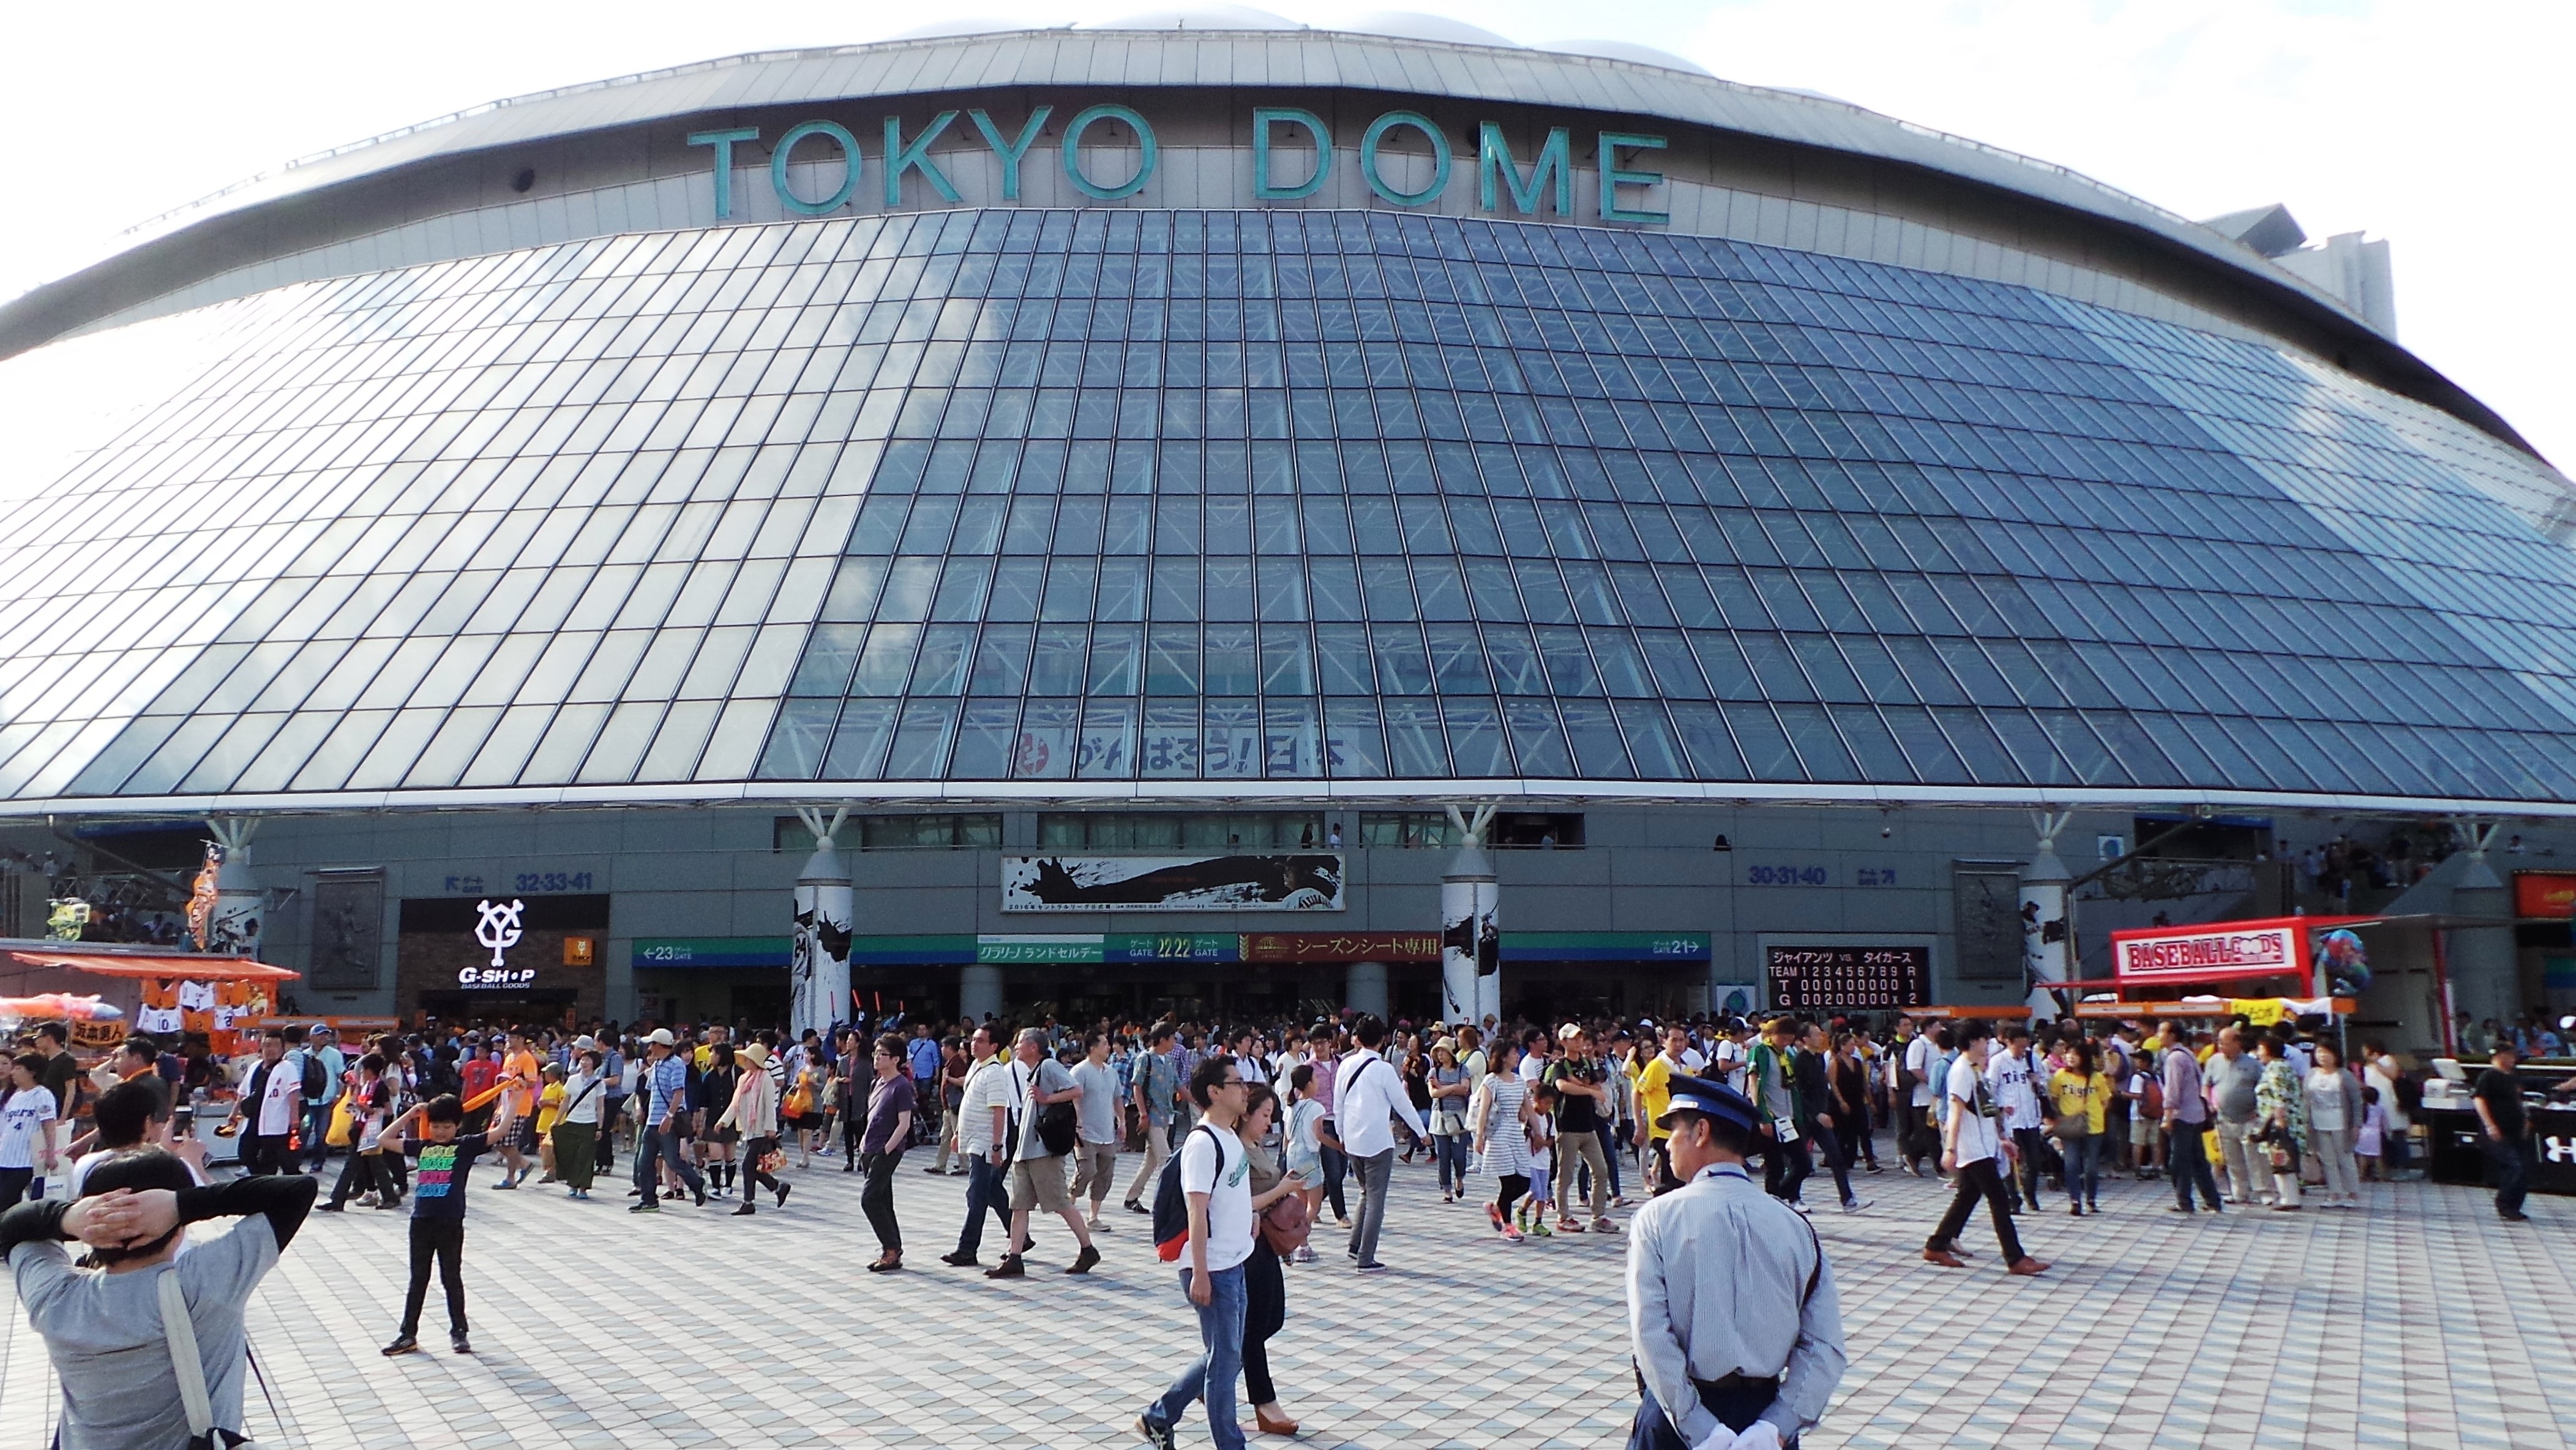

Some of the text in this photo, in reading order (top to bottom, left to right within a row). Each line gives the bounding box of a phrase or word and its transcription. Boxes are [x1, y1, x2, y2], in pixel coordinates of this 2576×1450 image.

[686, 103, 1669, 224] TOKYO DOME
[1130, 939, 1153, 948] ゲート
[1195, 939, 1218, 948] ゲート
[1296, 937, 1443, 955] シーズンシート専用
[1672, 939, 1688, 953] 21
[655, 946, 673, 961] 23
[1024, 945, 1103, 960] ランドセルデー
[1129, 949, 1153, 957] GATE
[1195, 949, 1218, 957] GATE
[1774, 952, 1833, 963] ジャイアンツ
[1863, 952, 1912, 963] タイガース
[2127, 938, 2232, 971] BASEBALL
[1769, 966, 1797, 977] TEAM
[1778, 980, 1789, 991] T
[1779, 994, 1791, 1005] G
[13, 1122, 22, 1130] 4
